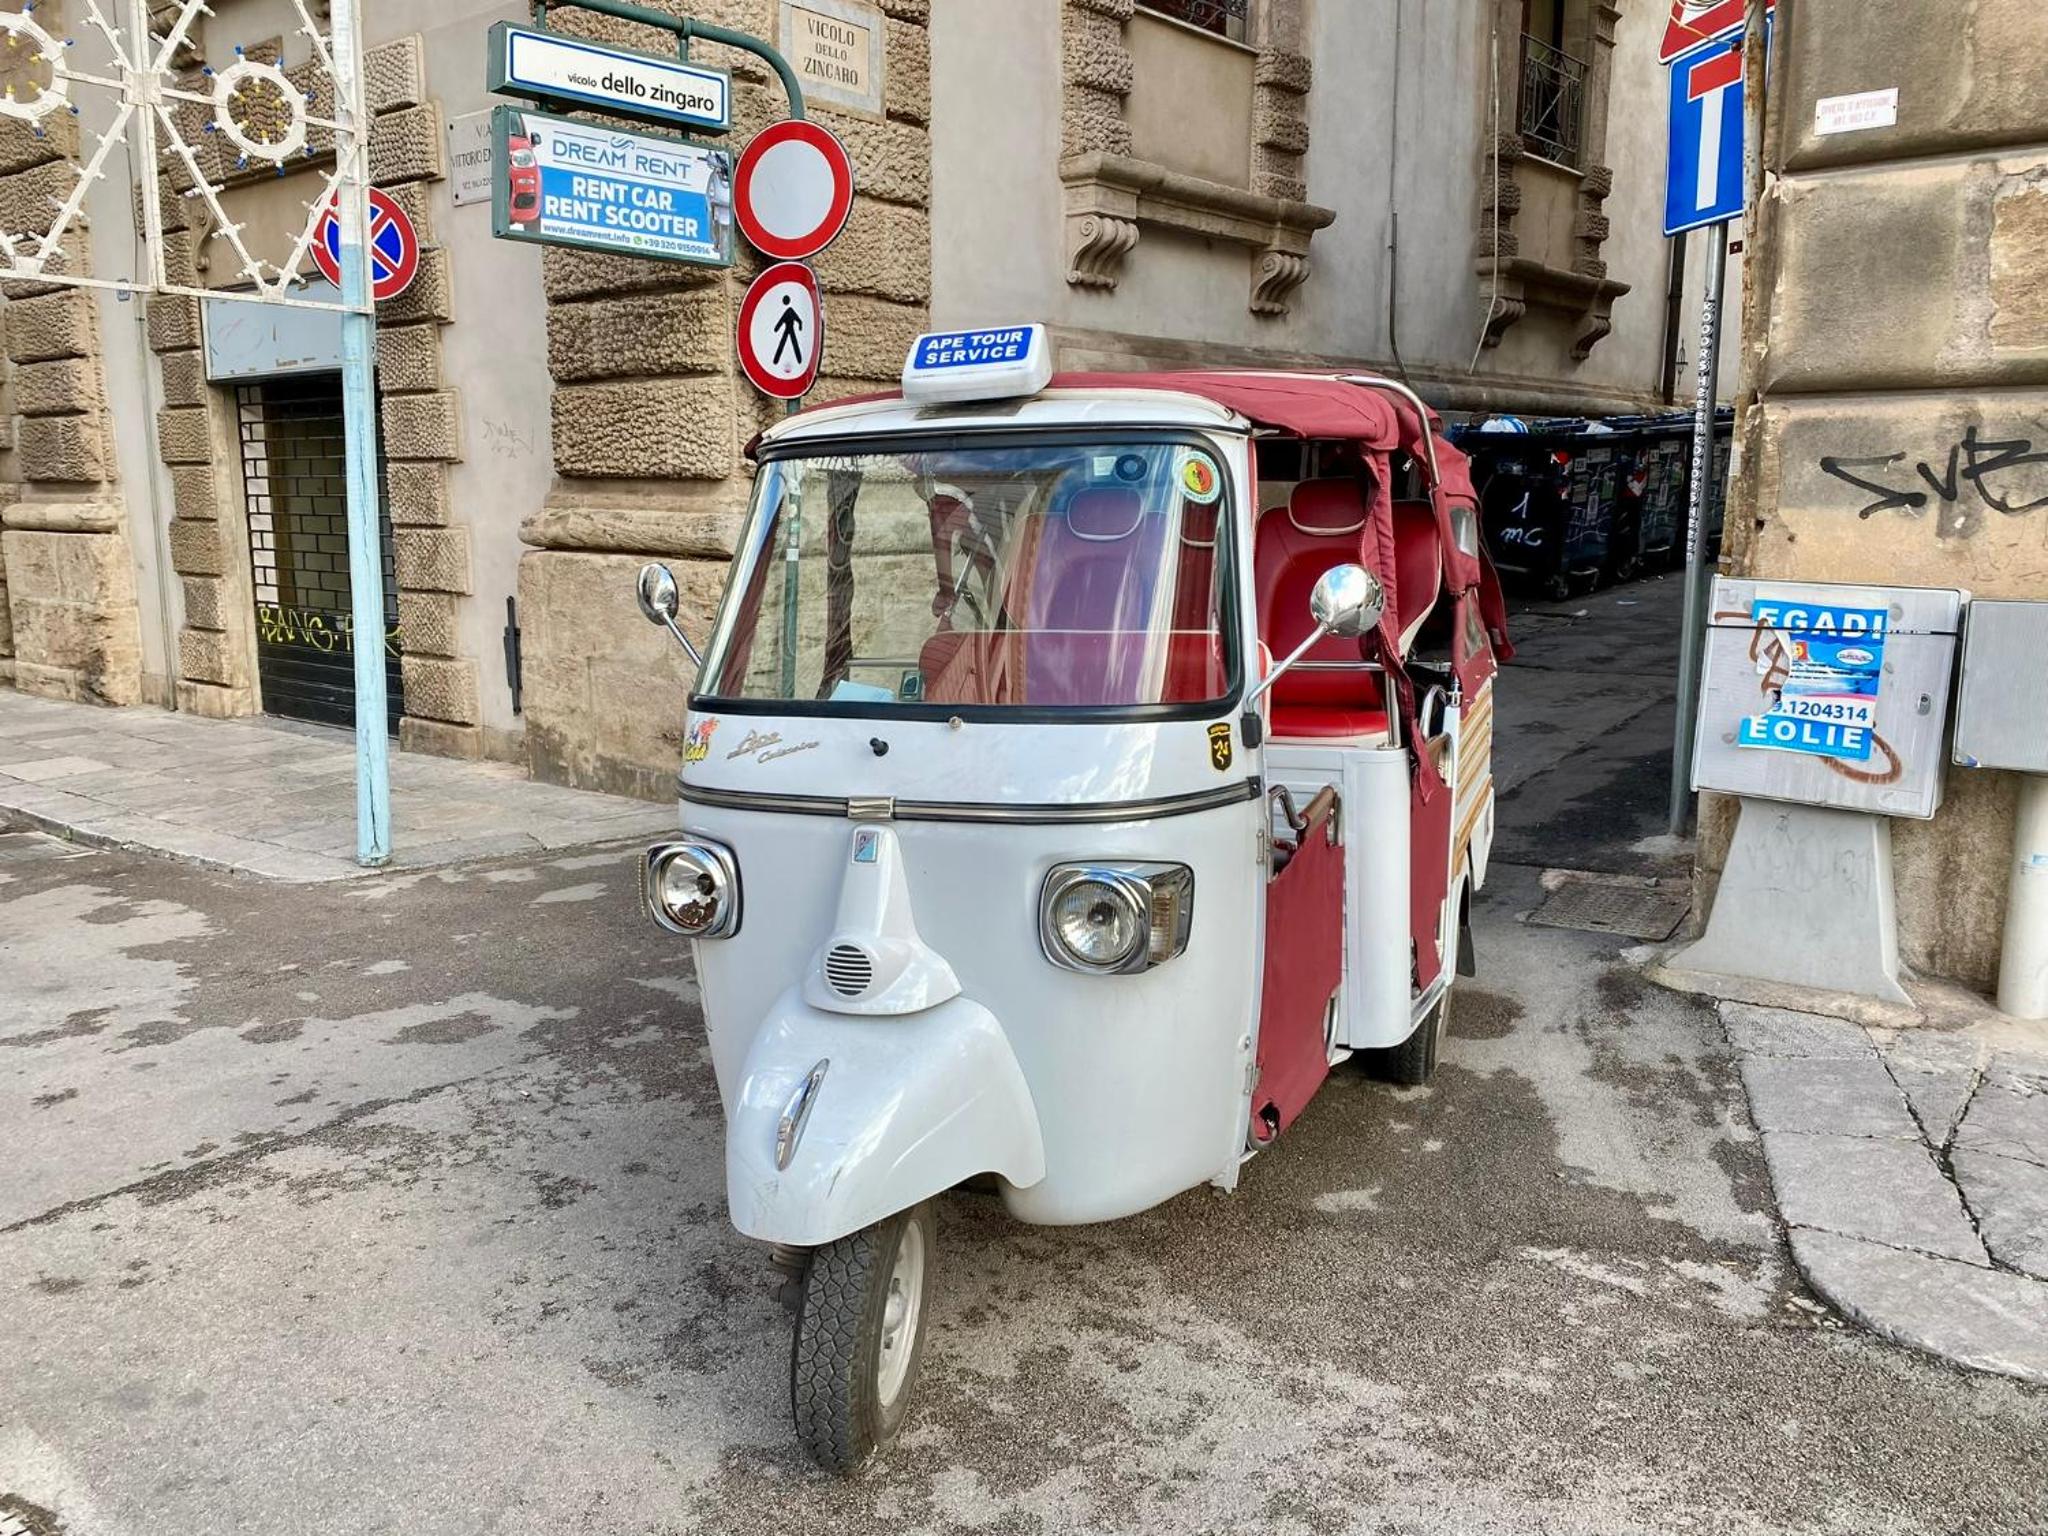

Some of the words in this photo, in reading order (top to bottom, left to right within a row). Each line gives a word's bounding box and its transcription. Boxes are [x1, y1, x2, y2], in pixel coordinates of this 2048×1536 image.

[807, 18, 855, 47] VICOLO
[816, 42, 848, 61] DELLO
[568, 73, 597, 87] vicolo
[602, 73, 646, 97] dello
[650, 84, 715, 111] zingaro
[552, 139, 627, 168] DREAM
[635, 157, 691, 179] RENT
[572, 176, 628, 204] RENT
[631, 186, 673, 211] CAR
[544, 195, 603, 223] RENT
[605, 205, 698, 238] SCOOTER
[543, 223, 631, 244] www.dreamrent.info
[925, 345, 1018, 365] SERVICE
[926, 336, 965, 351] APE
[971, 330, 1024, 346] TOUR
[1748, 717, 1864, 749] EOLIE
